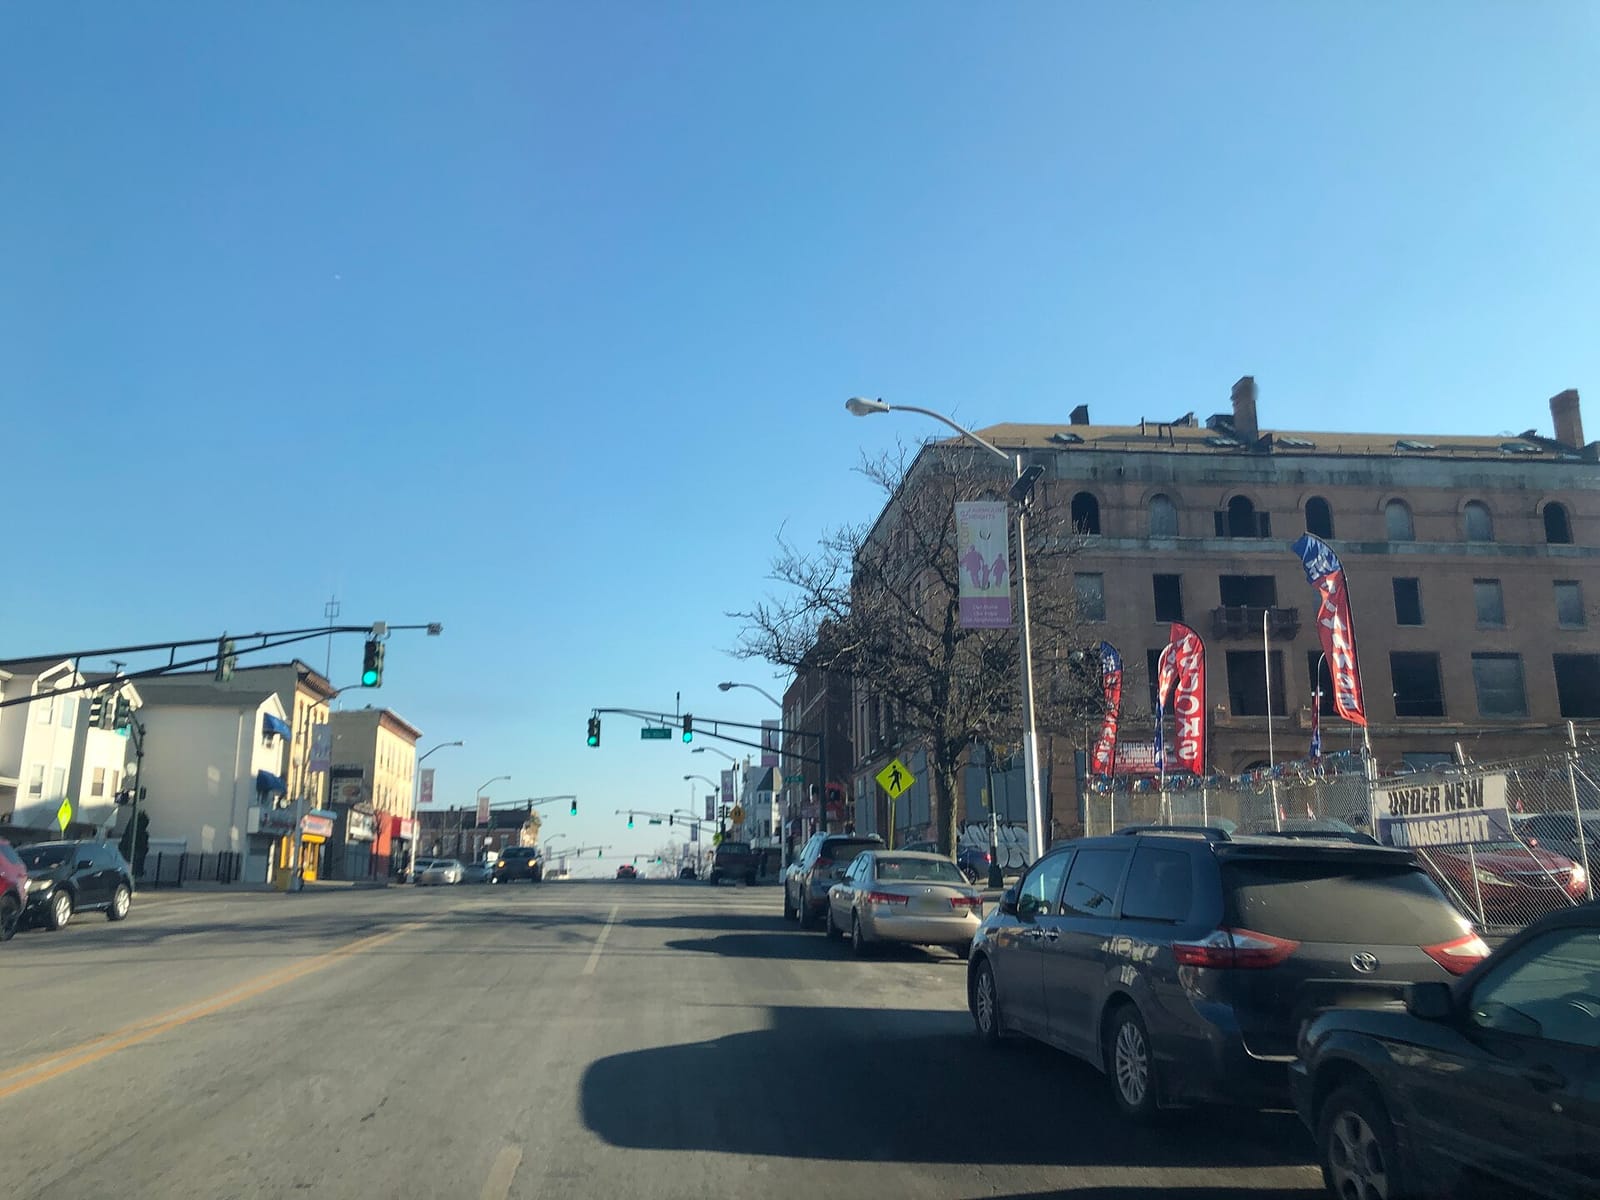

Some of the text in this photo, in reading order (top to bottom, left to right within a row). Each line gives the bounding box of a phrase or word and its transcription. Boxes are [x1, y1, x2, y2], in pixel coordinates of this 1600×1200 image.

[1388, 778, 1484, 816] UNDER NEW
[1391, 814, 1489, 847] MANAGEMENT
